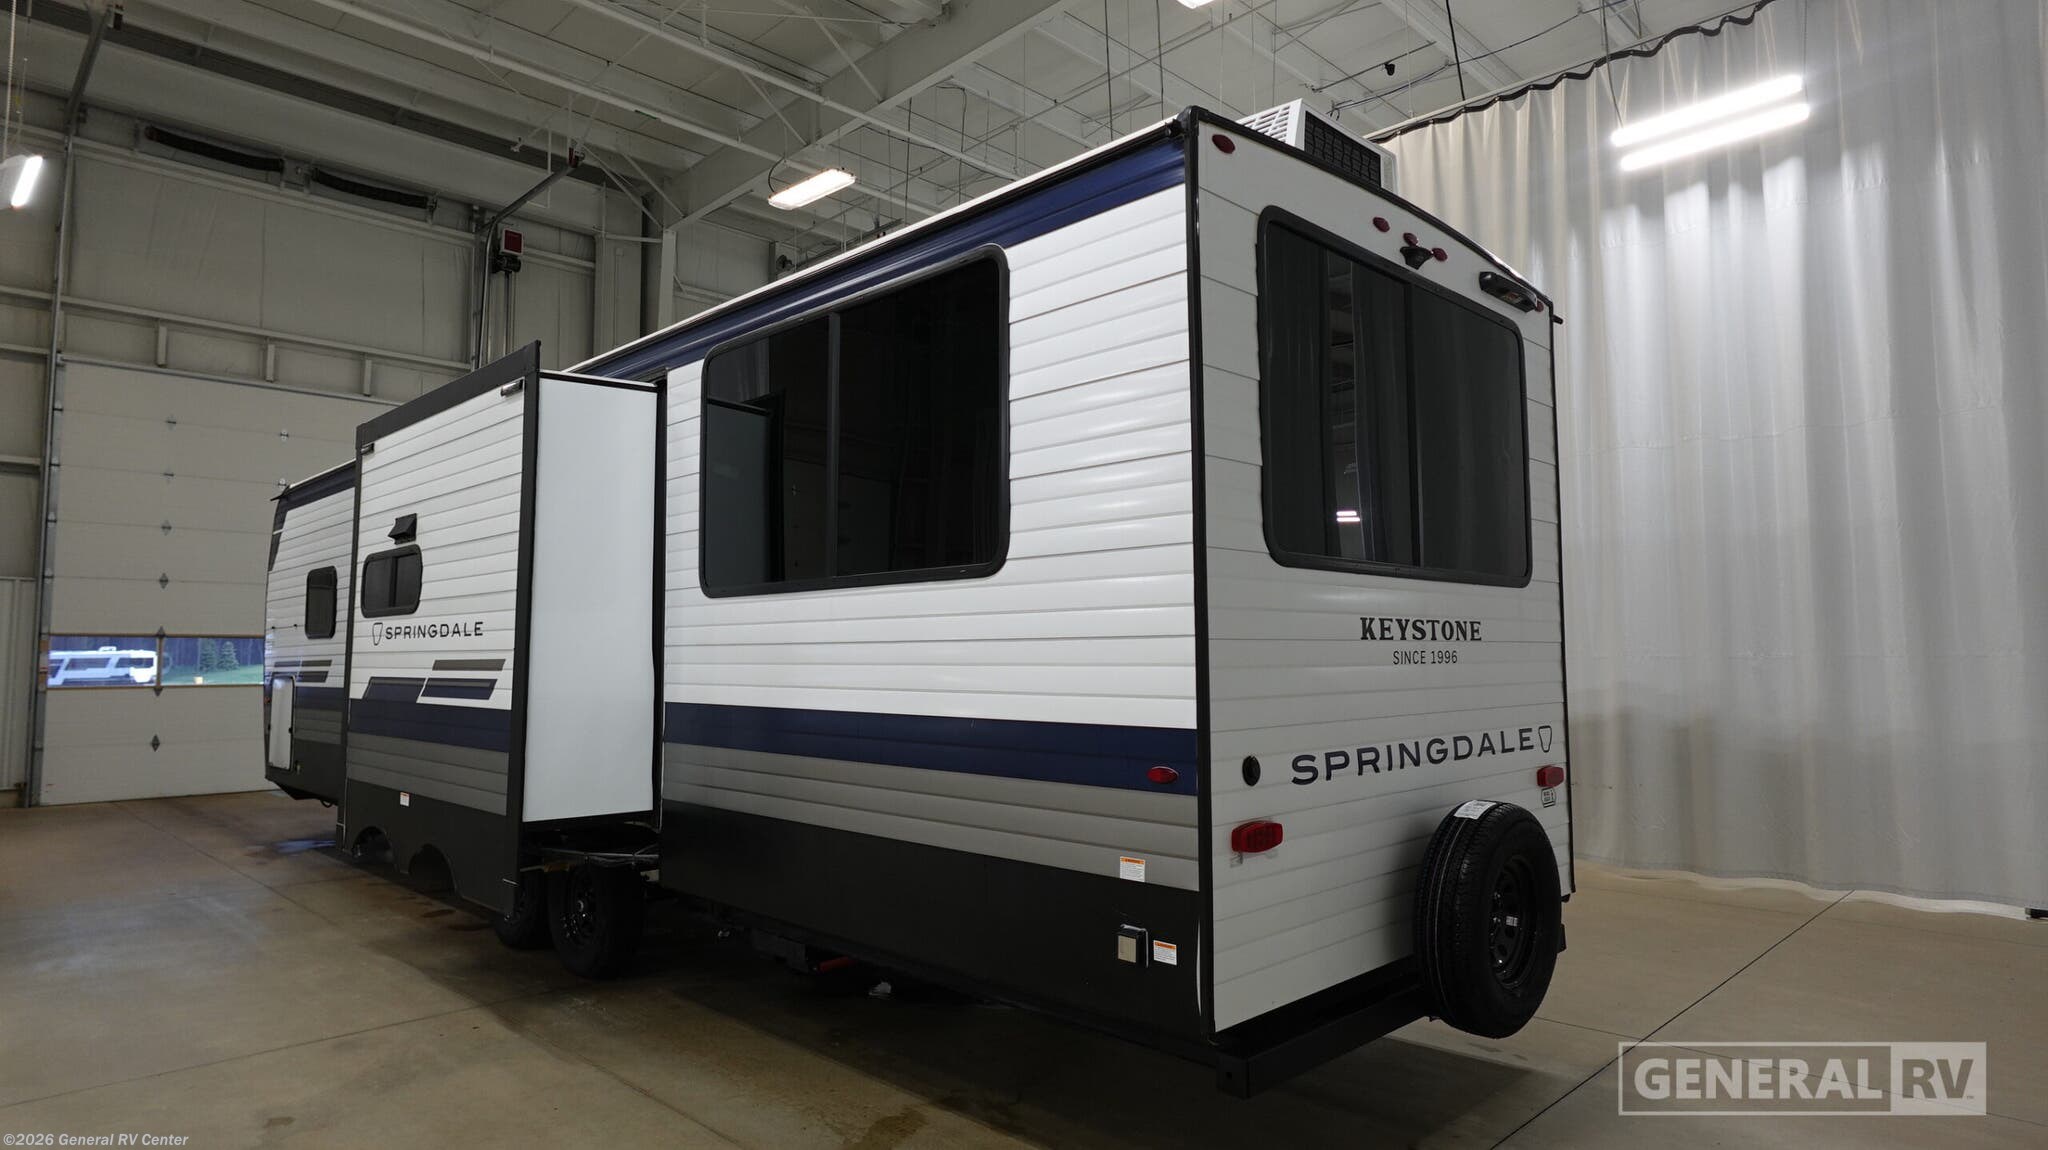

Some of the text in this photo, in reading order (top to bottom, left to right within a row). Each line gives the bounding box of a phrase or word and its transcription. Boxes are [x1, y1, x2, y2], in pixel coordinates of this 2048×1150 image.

[385, 621, 483, 639] SPRINGDALE
[1360, 617, 1482, 641] KEYSTONE
[1393, 650, 1458, 665] SINCE 1996
[1291, 727, 1534, 785] SPRINGDALE
